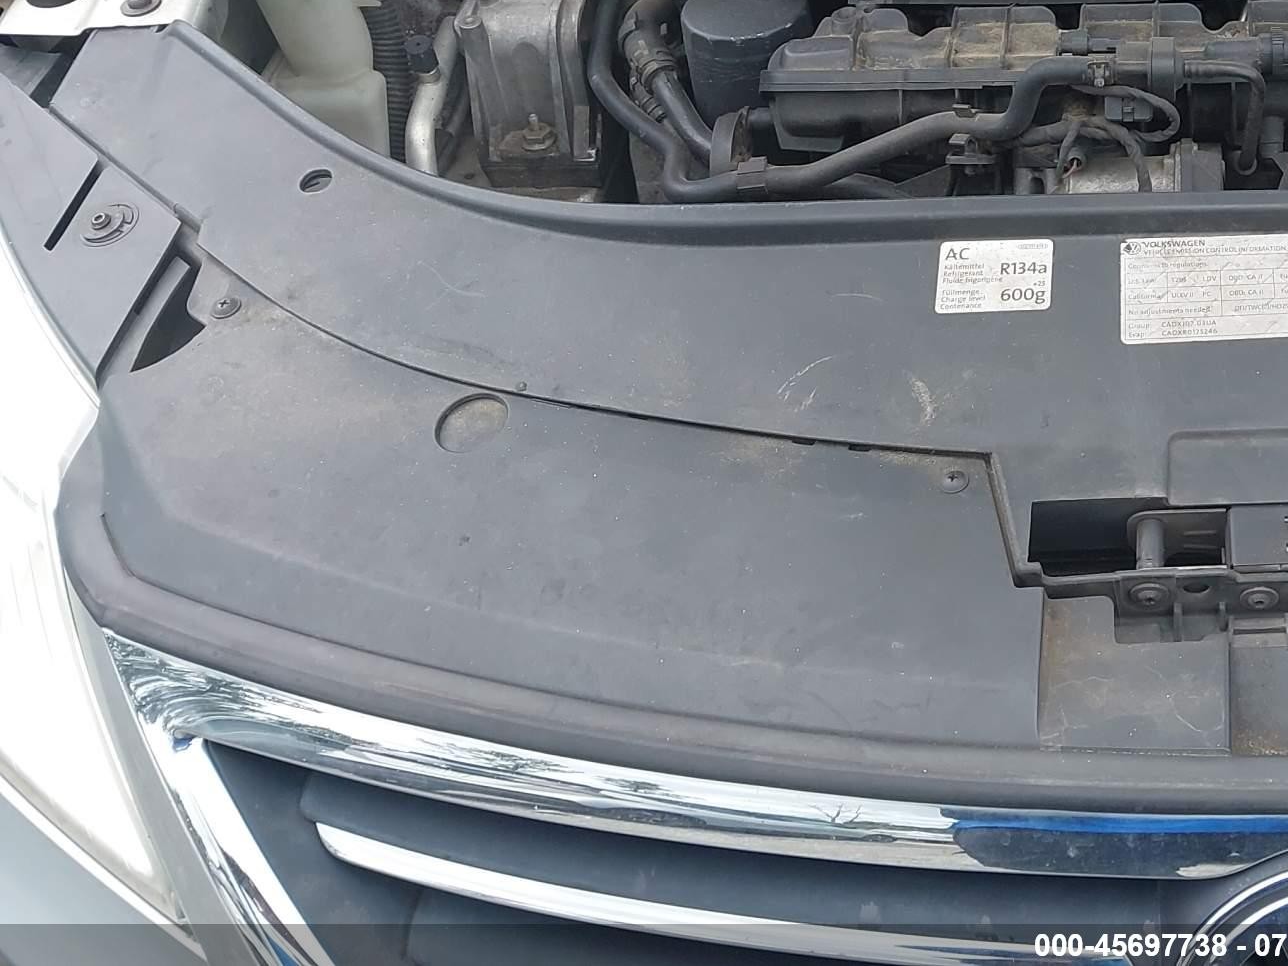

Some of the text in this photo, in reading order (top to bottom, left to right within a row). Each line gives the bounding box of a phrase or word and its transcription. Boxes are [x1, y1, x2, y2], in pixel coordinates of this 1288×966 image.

[1143, 239, 1206, 248] VOLKSWAGEN
[945, 247, 970, 260] AC
[1000, 262, 1047, 274] R134a
[941, 296, 967, 304] Charge
[1000, 288, 1046, 305] 600g
